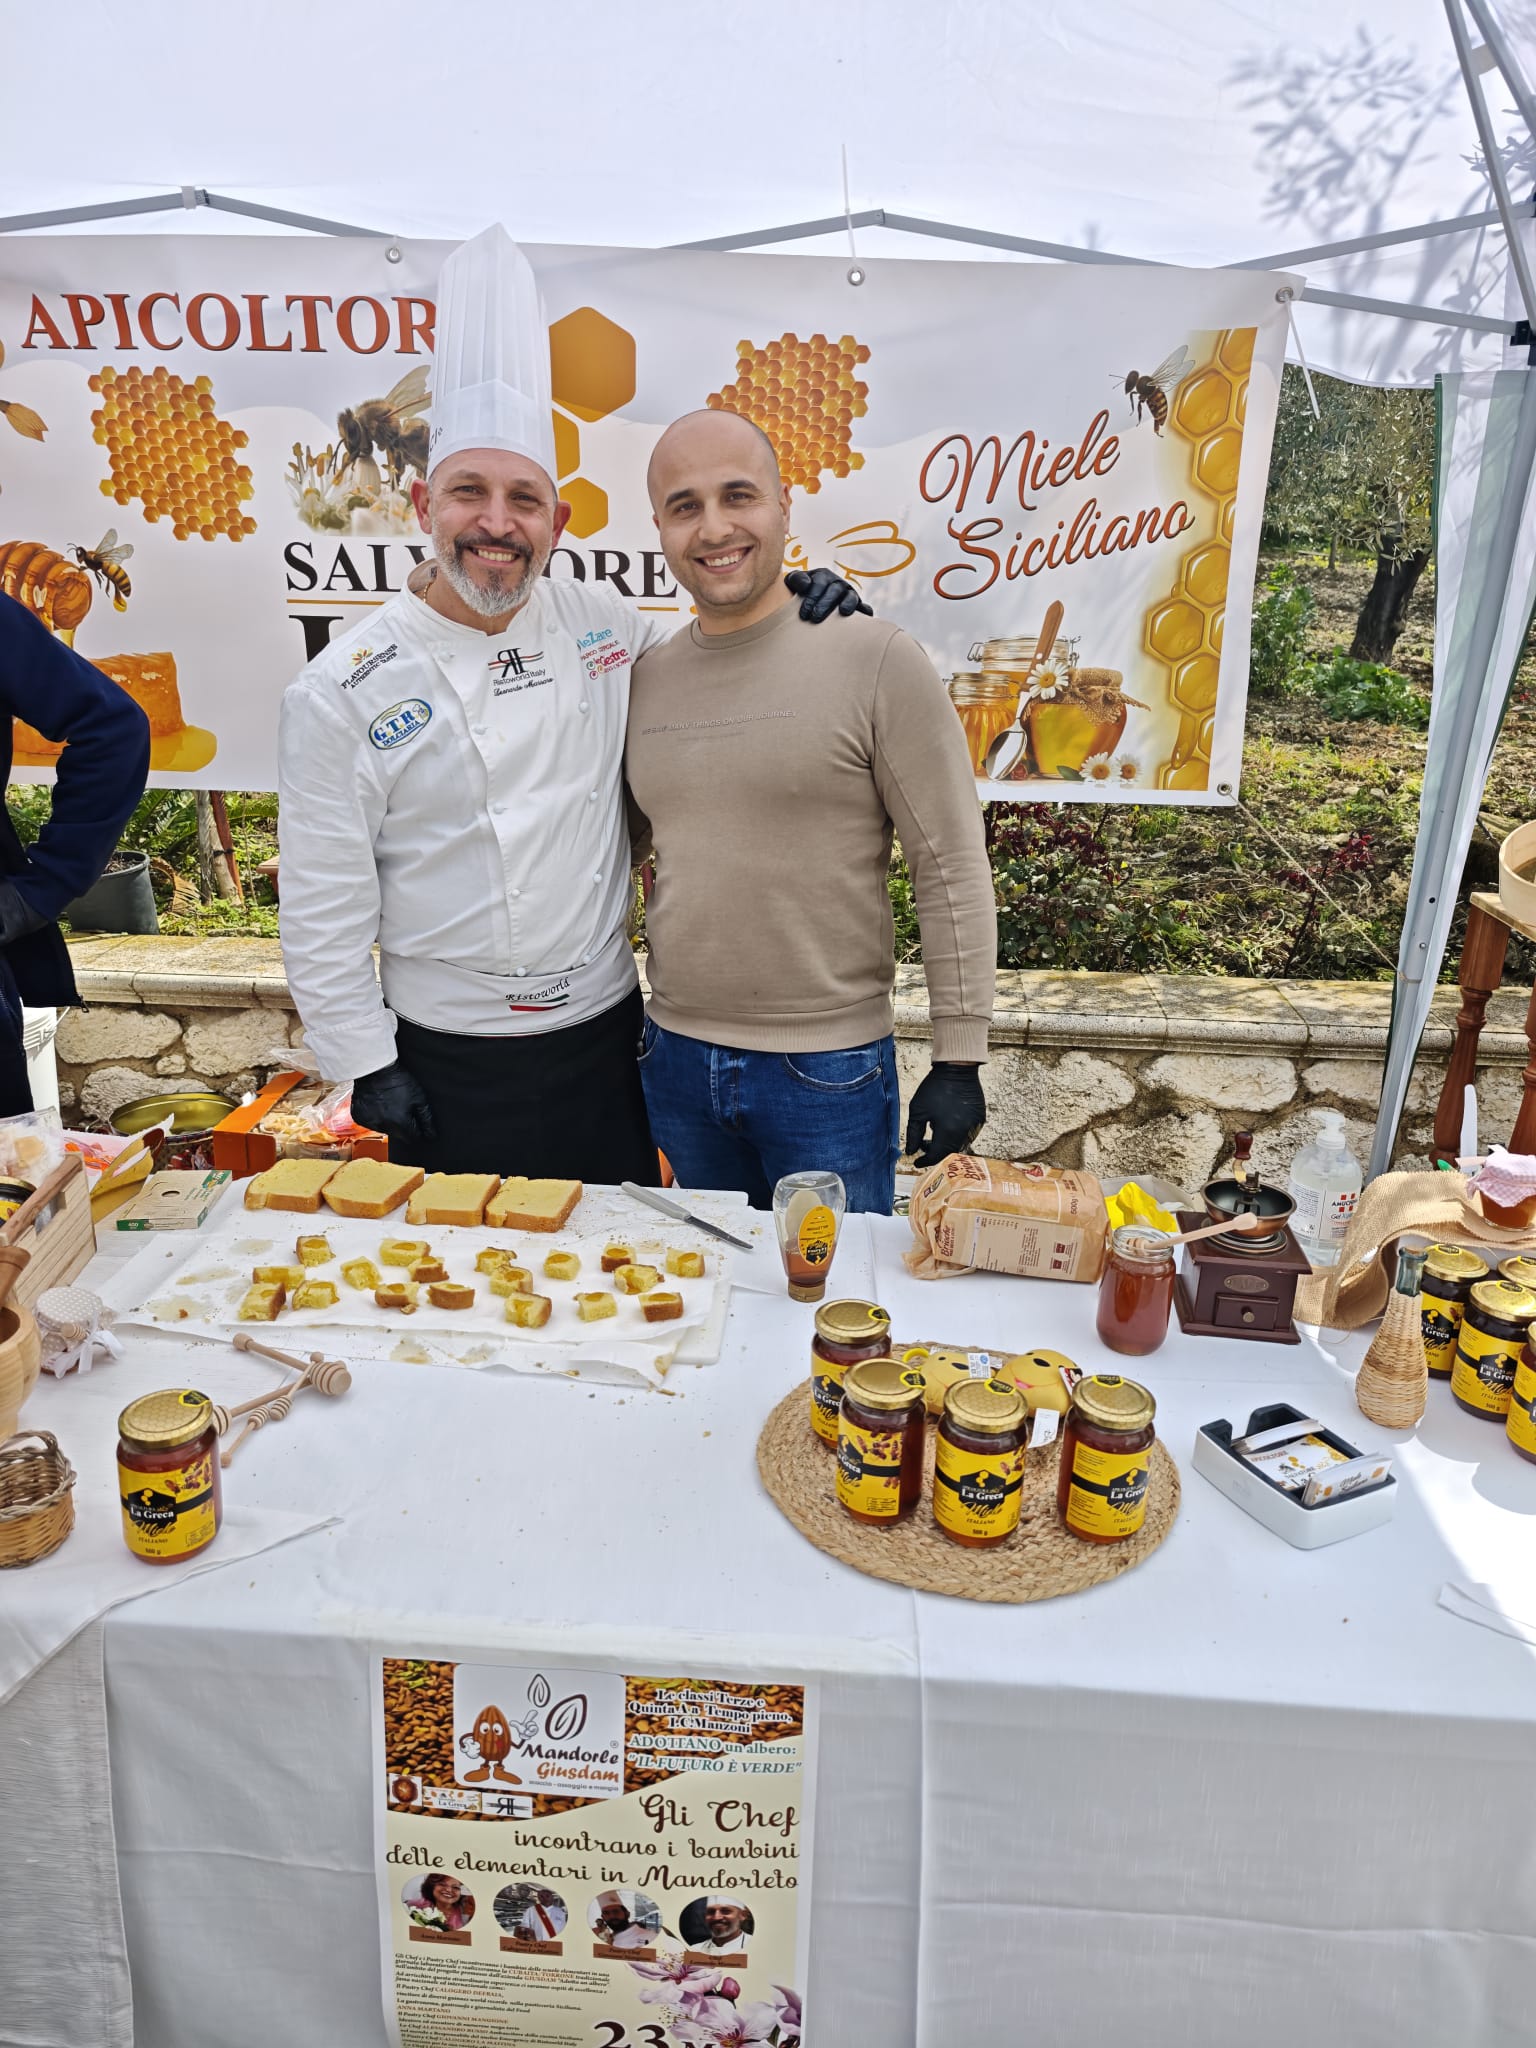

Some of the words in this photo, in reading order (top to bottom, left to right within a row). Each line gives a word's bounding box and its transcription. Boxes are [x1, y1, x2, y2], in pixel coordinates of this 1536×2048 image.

[21, 293, 436, 355] APICOLTOR
[919, 409, 1120, 513] Miele
[933, 497, 1195, 600] Siciliano
[340, 644, 398, 690] FLAVOURSENSE
[351, 660, 381, 689] AUTHENTIC
[493, 672, 530, 686] Ristoworld
[529, 669, 546, 680] Italy
[382, 721, 420, 746] DOLCIARIA
[692, 718, 721, 729] THINGS
[1480, 1365, 1492, 1378] La
[1493, 1371, 1514, 1382] Grec
[961, 1487, 974, 1498] La
[976, 1491, 1004, 1501] Greca
[1110, 1490, 1123, 1499] La
[130, 1506, 141, 1518] La
[143, 1510, 174, 1519] Greca
[658, 1690, 675, 1701] Le
[678, 1690, 714, 1702] classi
[716, 1693, 755, 1707] Terze
[756, 1699, 764, 1707] e
[629, 1701, 675, 1715] Quinta
[677, 1704, 688, 1714] A
[690, 1706, 699, 1714] a
[705, 1705, 750, 1720] Tempo
[520, 1744, 619, 1765] Mandorle
[629, 1735, 721, 1751] ADOTTANO
[725, 1744, 742, 1753] un
[746, 1743, 796, 1755] albero:
[537, 1761, 619, 1783] Giusdam
[657, 1757, 724, 1772] FUTURO
[728, 1759, 739, 1773] È
[742, 1761, 802, 1774] VERDE"
[639, 1793, 694, 1833] Gli
[707, 1799, 800, 1837] Chef
[514, 1829, 658, 1856] incontrano
[668, 1841, 678, 1857] i
[688, 1838, 800, 1859] bambini
[386, 1844, 446, 1868] delle
[454, 1851, 592, 1880] elementari
[601, 1867, 628, 1884] in
[638, 1864, 799, 1890] Mandorleto
[594, 2021, 670, 2048] 23
